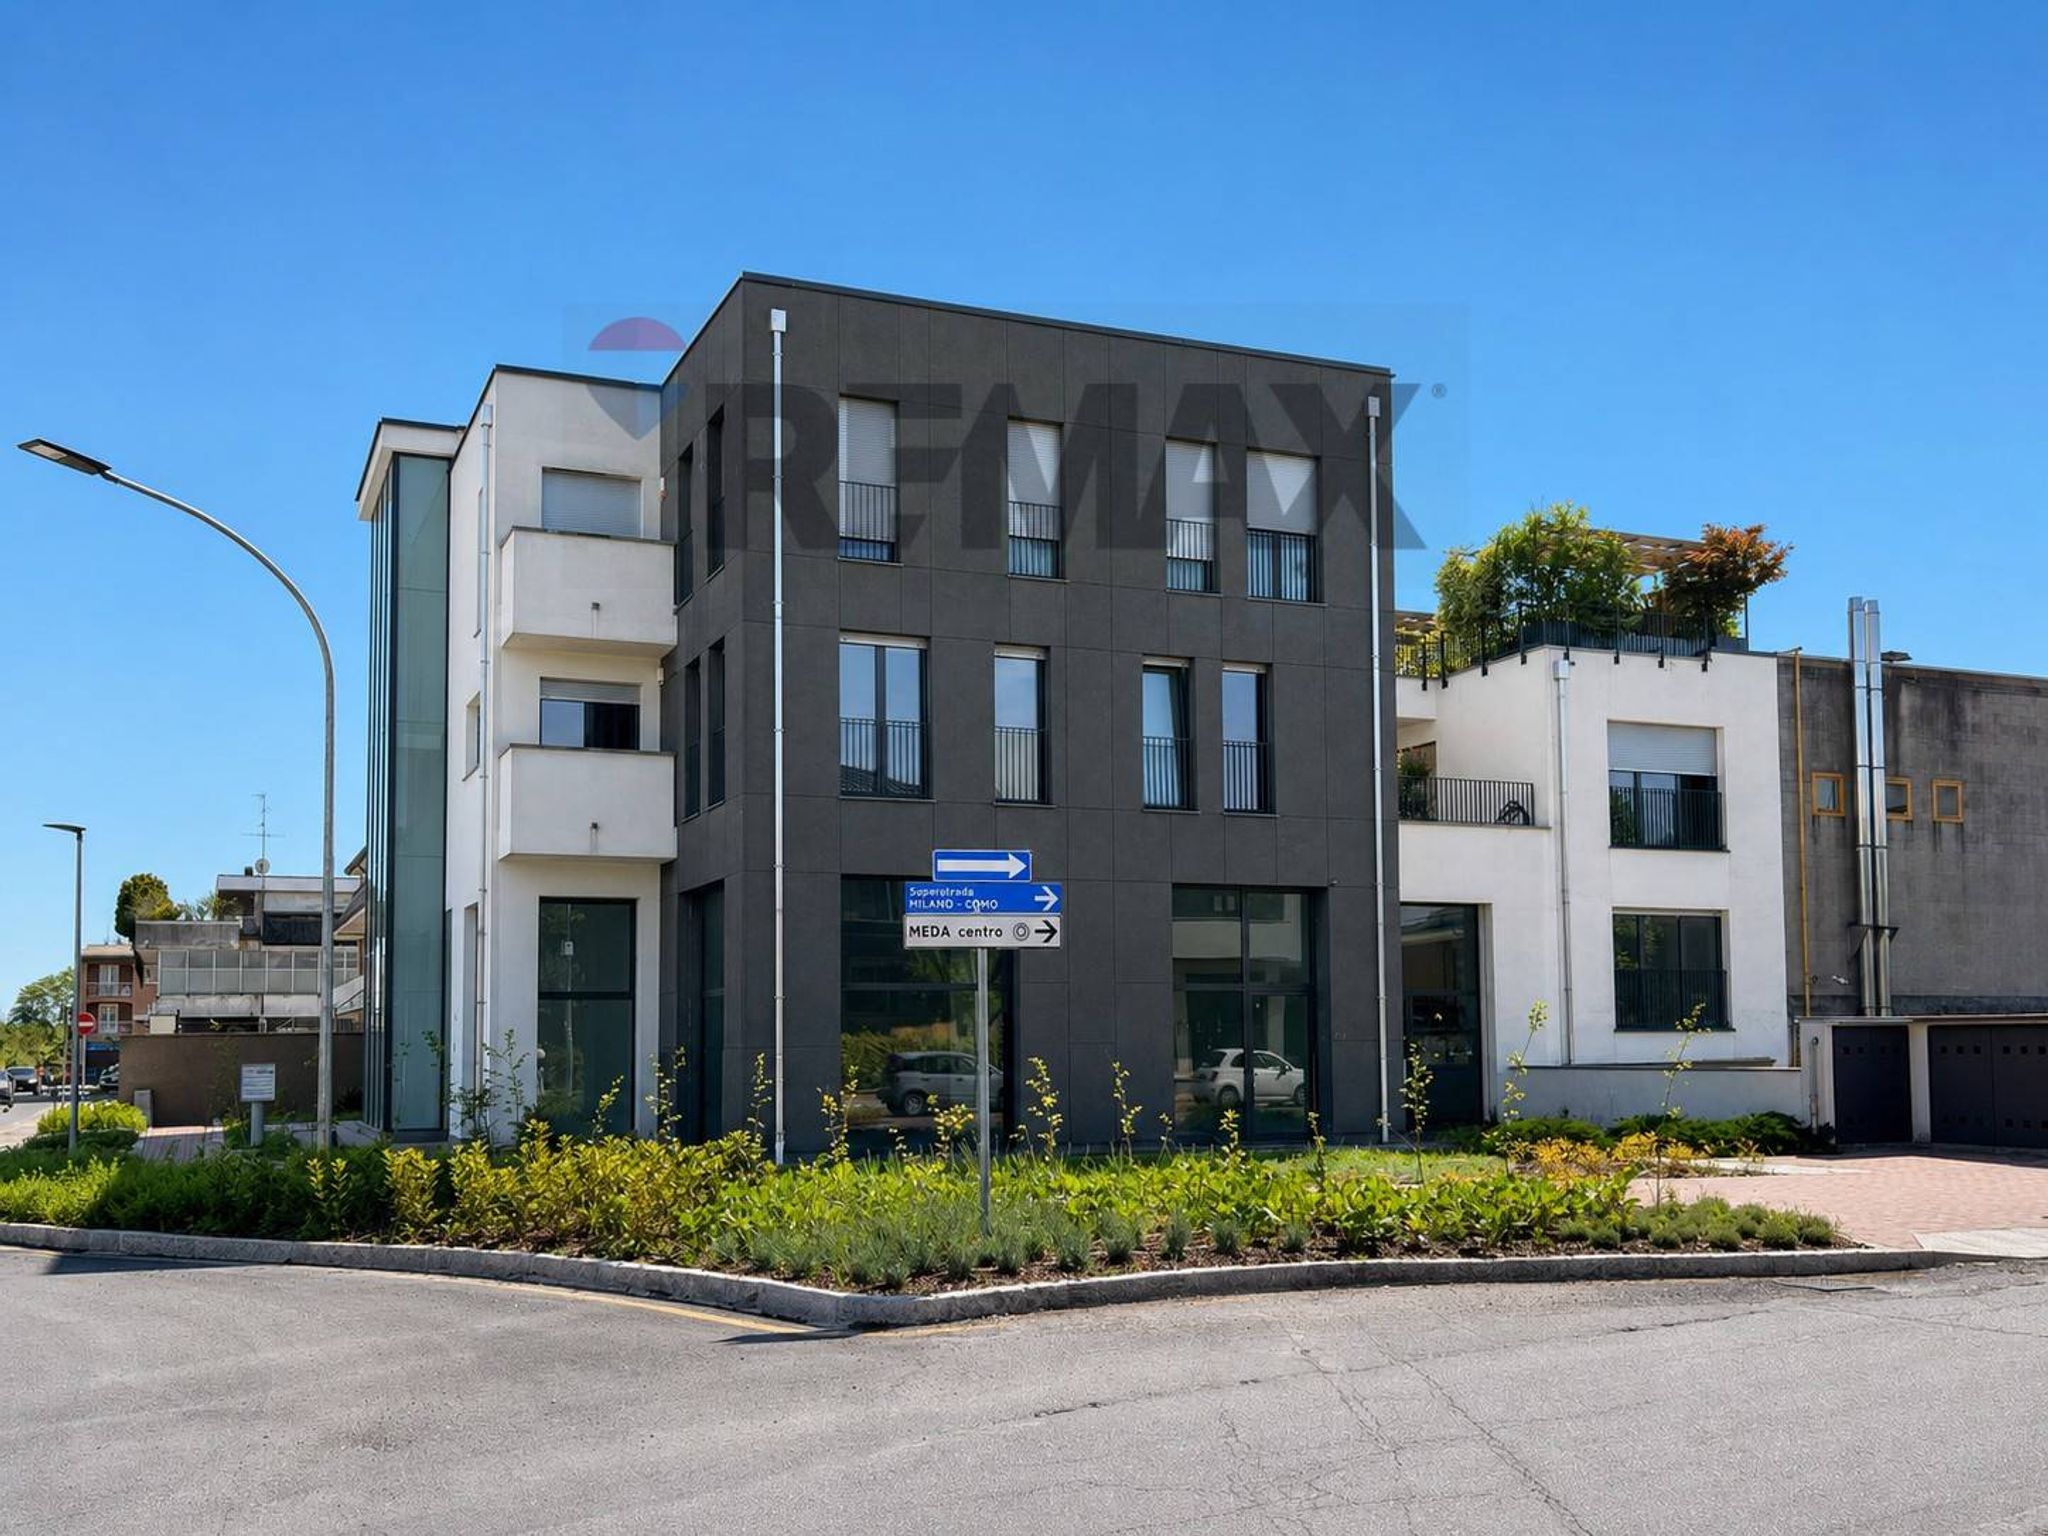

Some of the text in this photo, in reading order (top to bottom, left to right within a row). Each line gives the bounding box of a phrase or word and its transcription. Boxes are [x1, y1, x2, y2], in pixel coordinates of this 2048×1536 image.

[909, 899, 954, 909] MILANO
[965, 899, 999, 909] COMO
[909, 926, 1003, 938] MEDA centro
